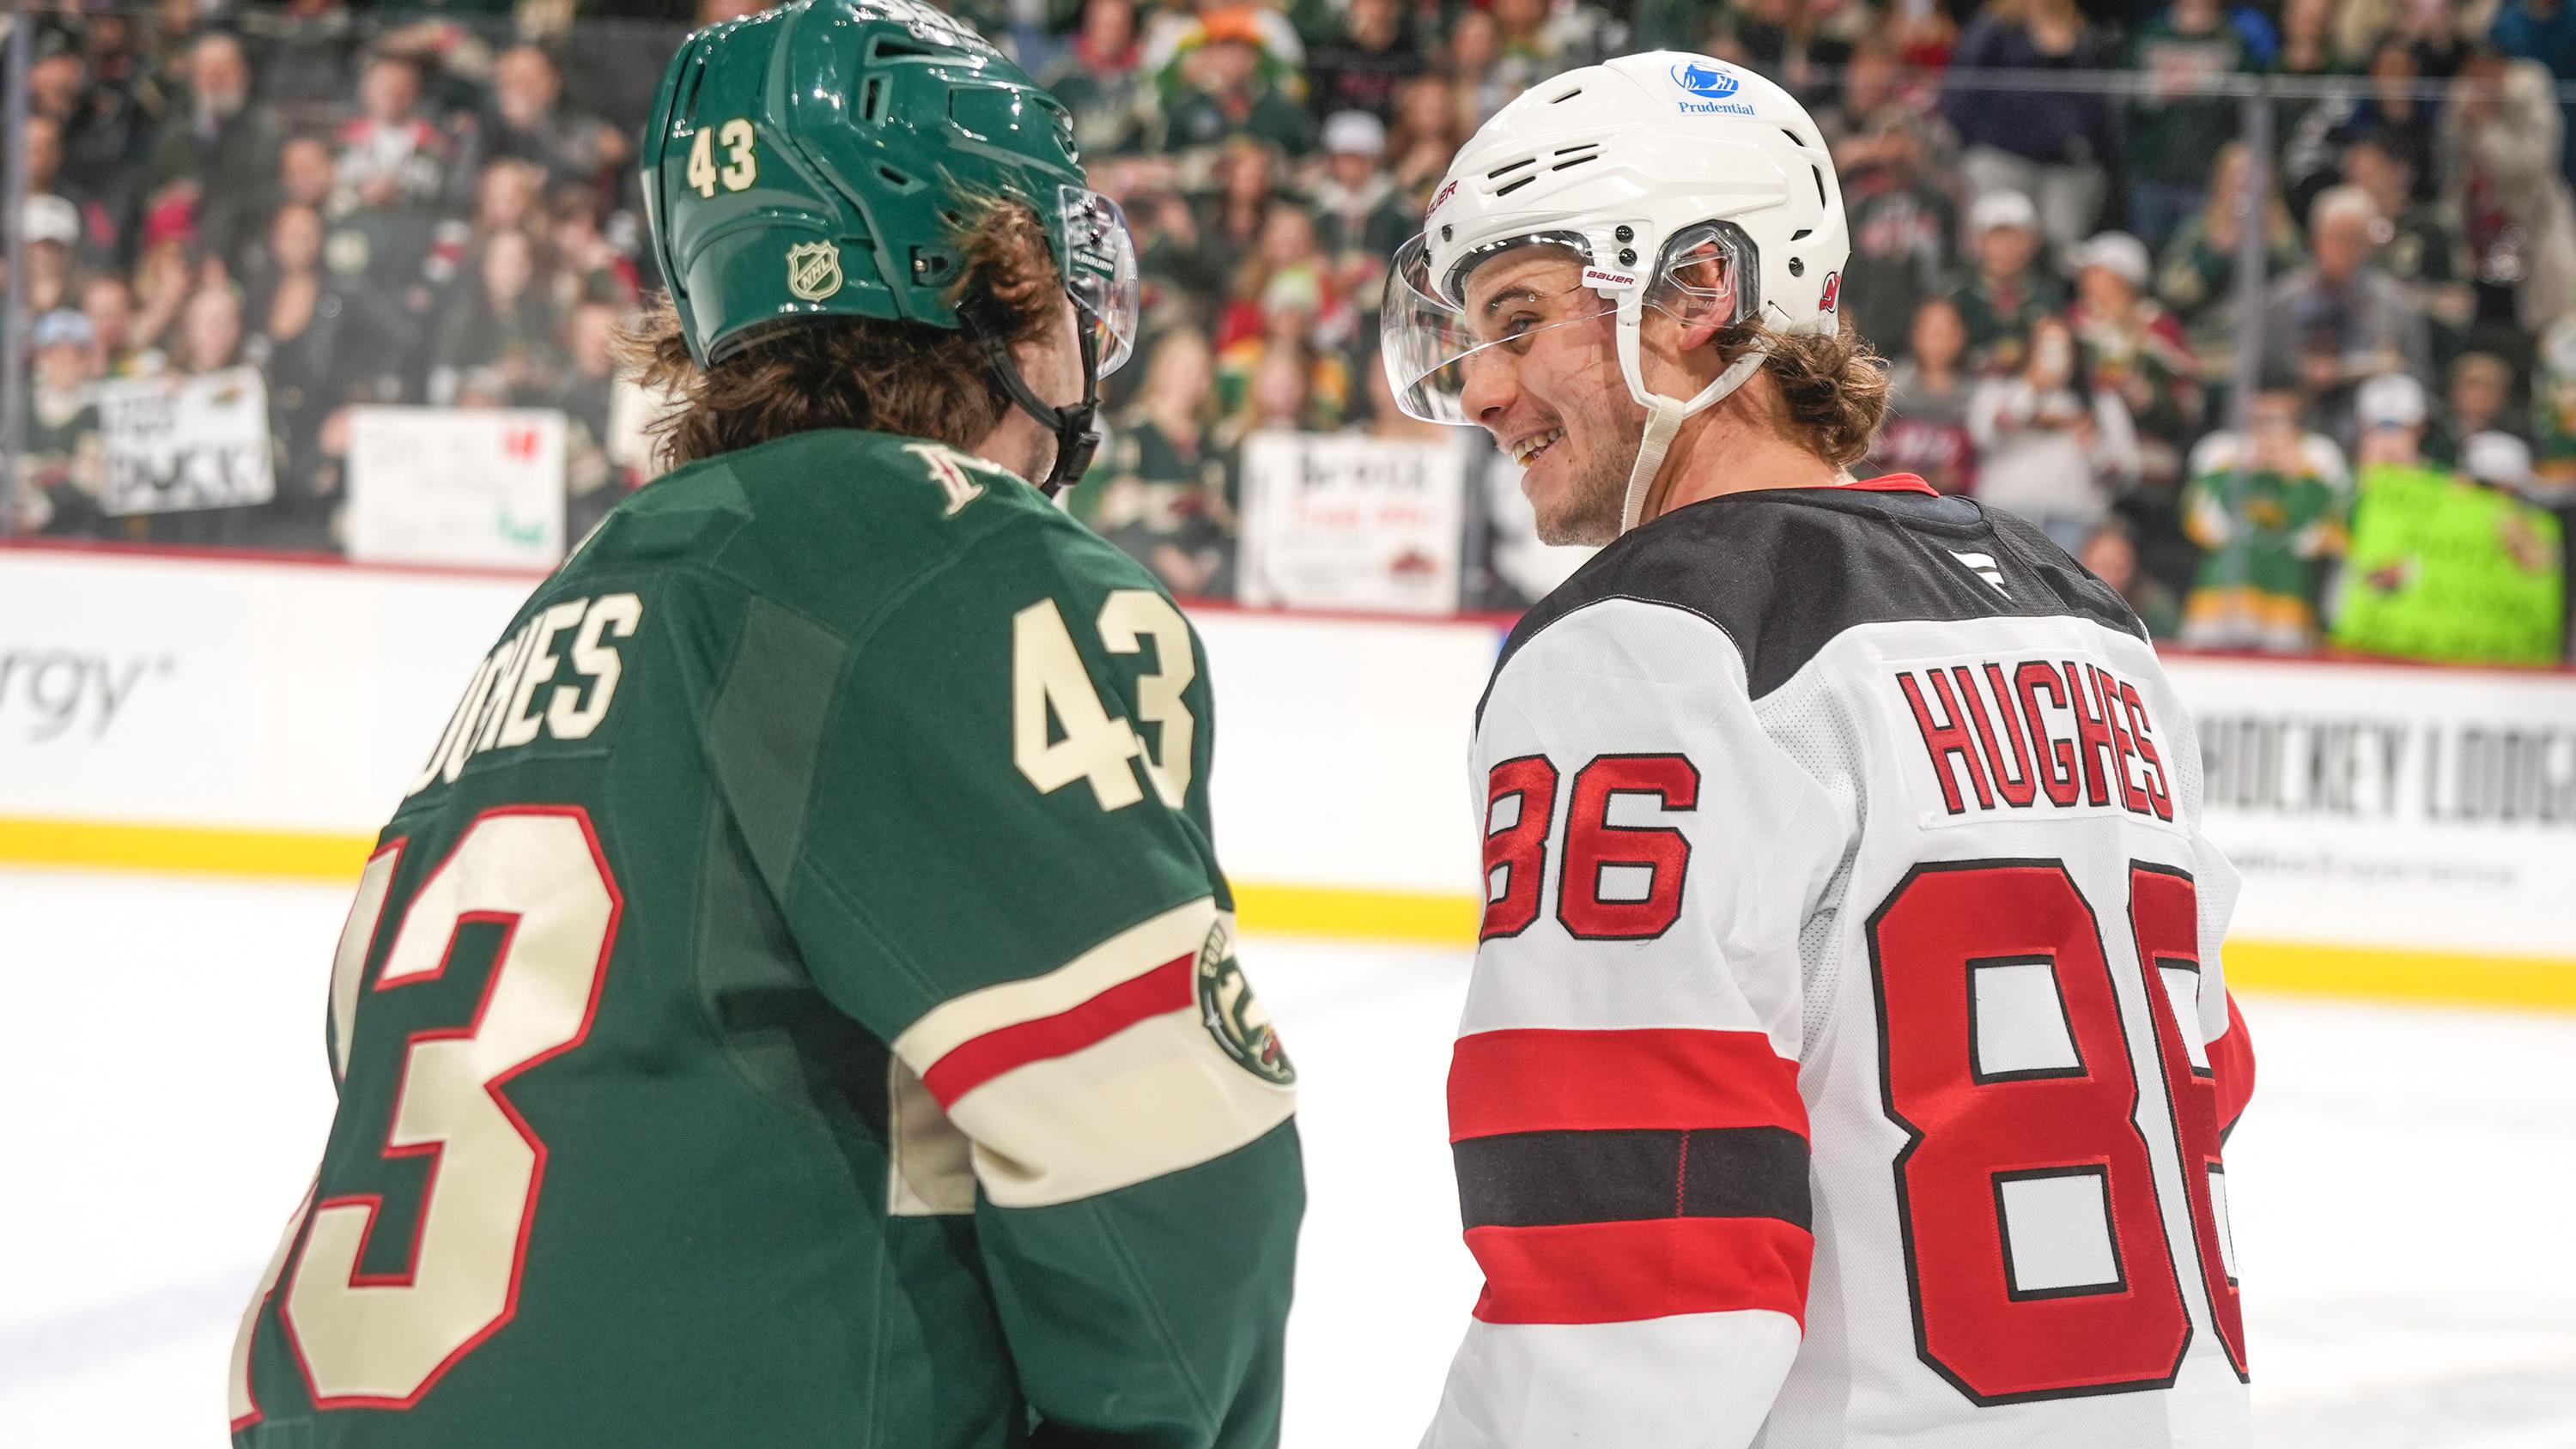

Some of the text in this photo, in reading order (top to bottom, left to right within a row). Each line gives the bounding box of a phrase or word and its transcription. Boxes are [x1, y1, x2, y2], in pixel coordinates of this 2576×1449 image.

[1678, 101, 1756, 116] Prudential
[687, 117, 757, 199] 43
[799, 257, 832, 290] NHL
[1080, 252, 1115, 272] BAUER
[1586, 270, 1635, 285] BAUER
[0, 648, 148, 740] rgy
[406, 592, 643, 797] GHES
[1012, 589, 1196, 812] 43
[1895, 660, 2173, 823] HUGHES
[2423, 723, 2576, 822] LODG
[1479, 752, 1701, 942] 86
[229, 804, 625, 1433] 3
